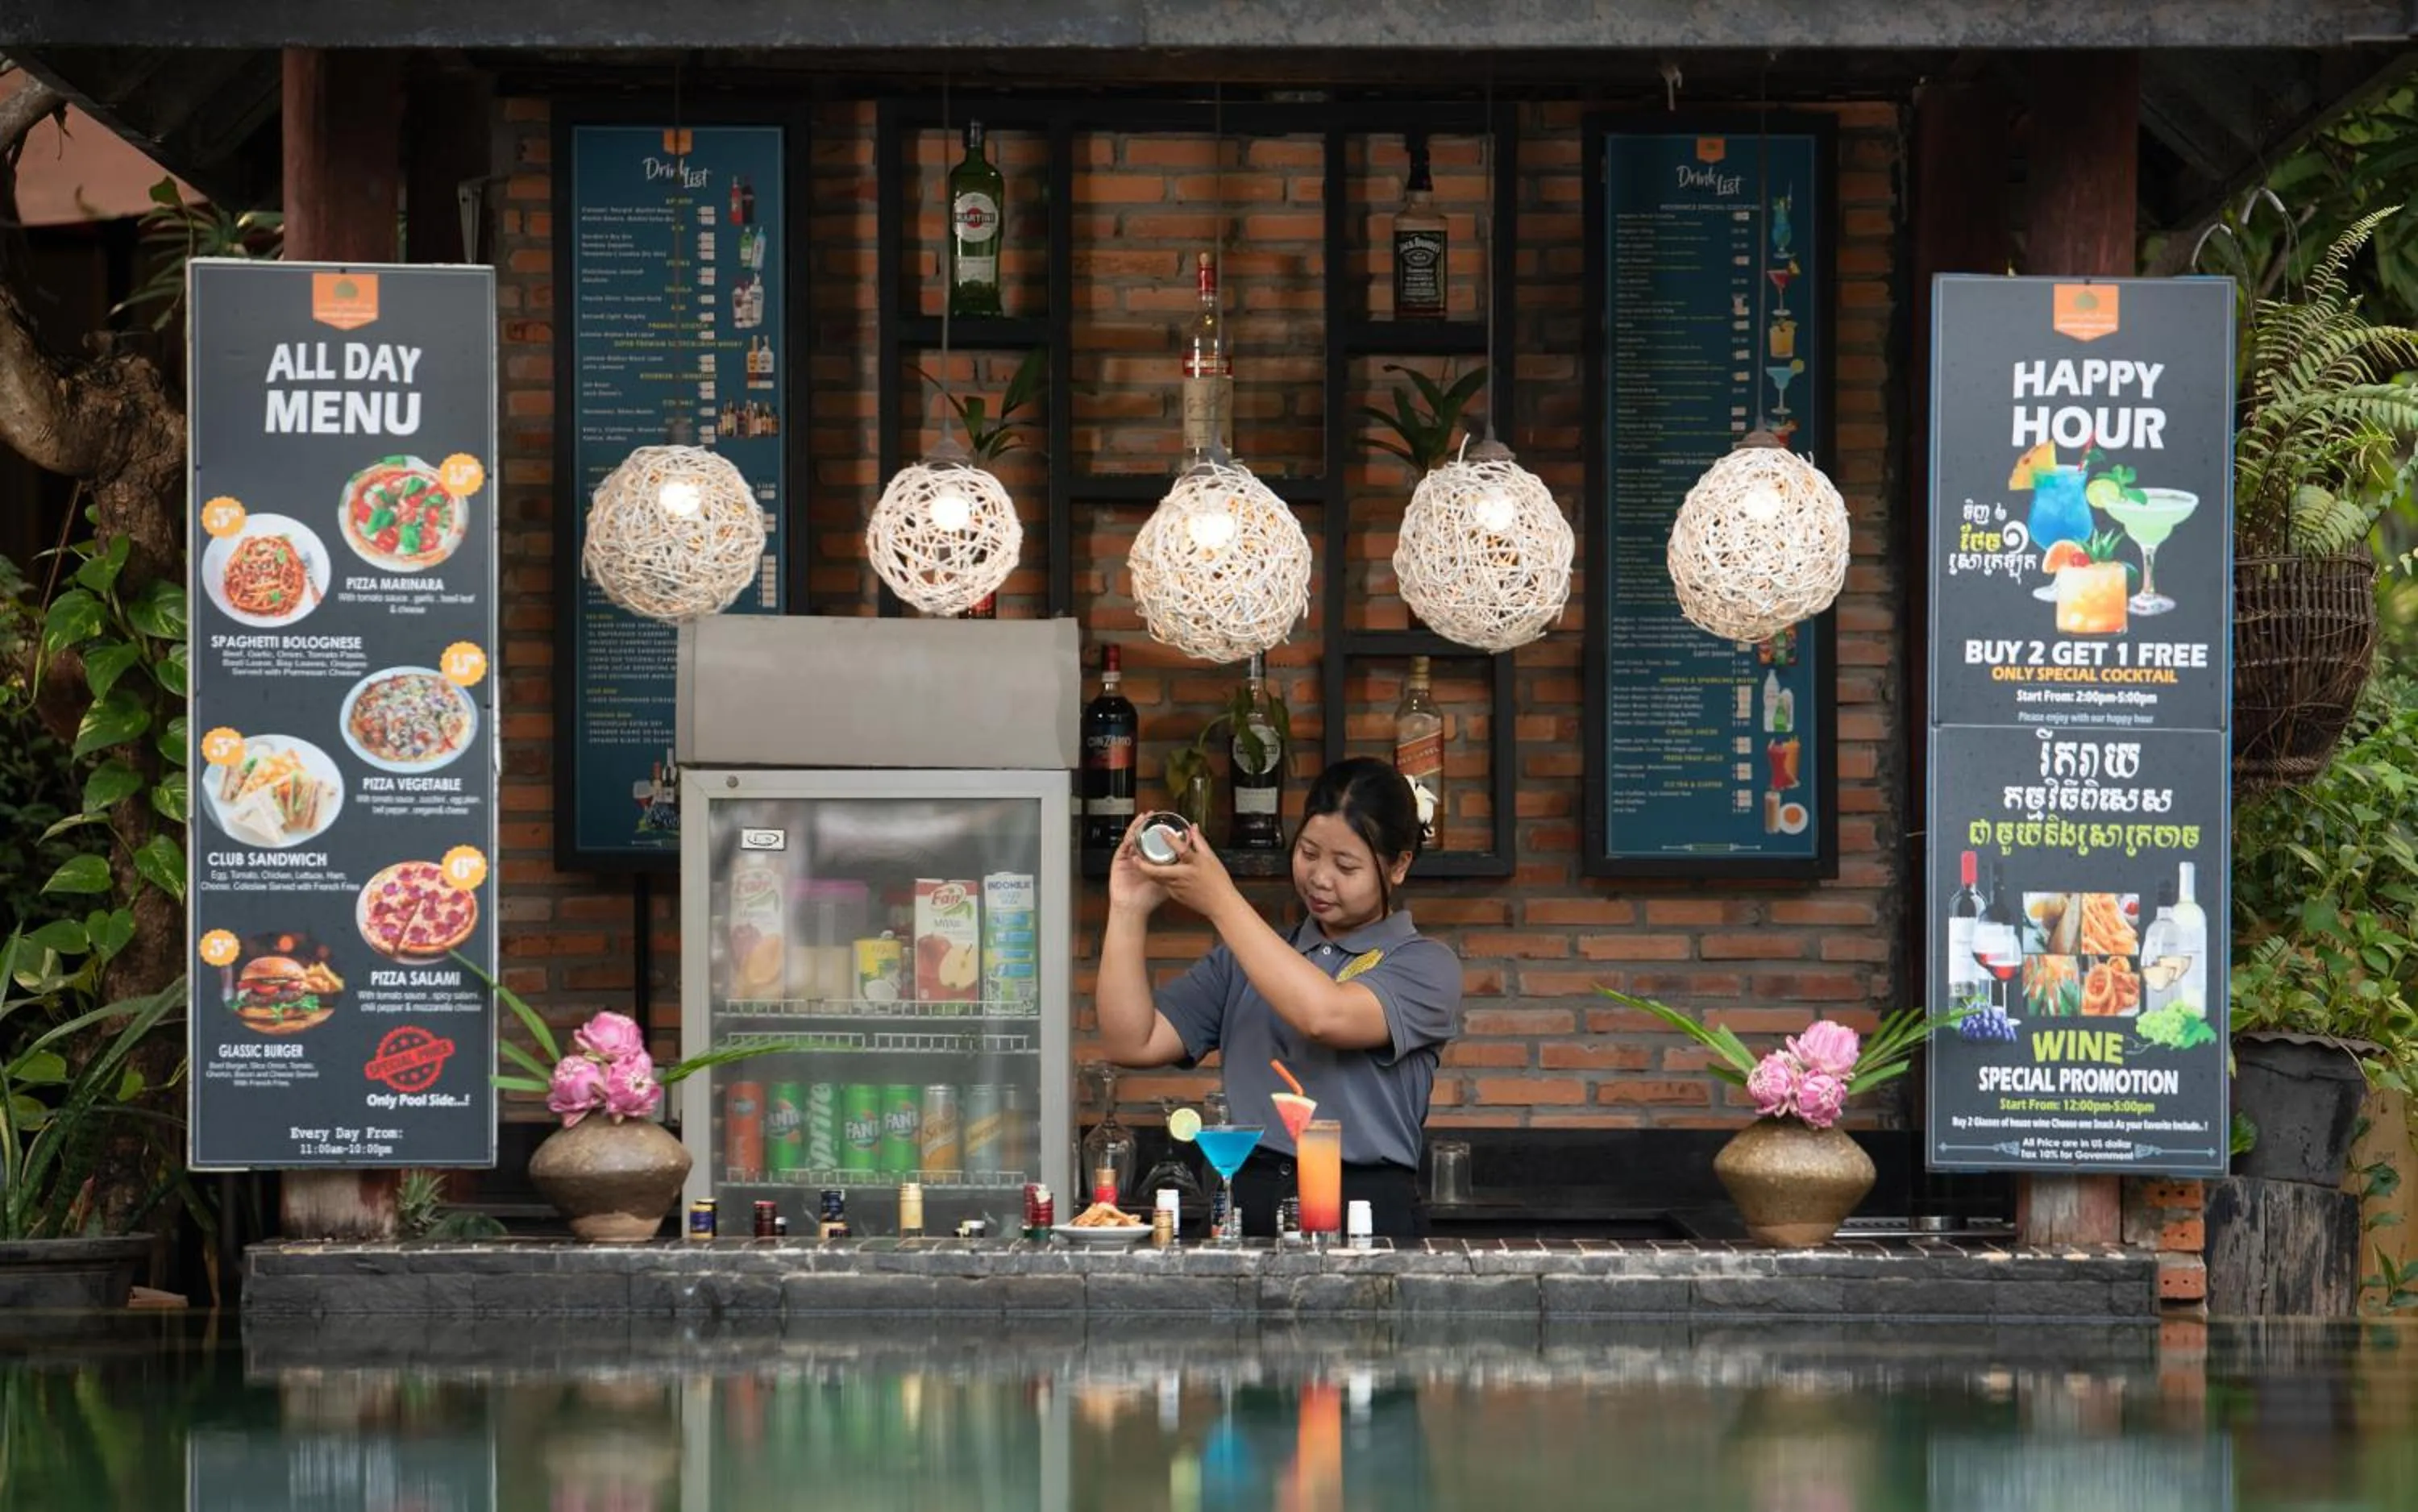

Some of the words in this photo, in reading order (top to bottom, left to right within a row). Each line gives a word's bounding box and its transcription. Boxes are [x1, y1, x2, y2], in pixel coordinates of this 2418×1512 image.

[1676, 164, 1716, 188] Drink
[1717, 176, 1746, 196] List
[266, 342, 335, 383] ALL
[344, 343, 422, 384] DAY
[2013, 359, 2164, 399] HAPPY
[265, 390, 422, 435] MENU
[2012, 406, 2167, 449] HOUR
[346, 577, 377, 590] PIZZA
[380, 578, 444, 591] MARINARA
[211, 635, 279, 648] SPAGHETTI
[283, 636, 362, 649] BOLOGNESE
[1965, 640, 2024, 664] BUY
[2028, 642, 2044, 665] 2
[2052, 642, 2108, 666] GET
[2117, 642, 2129, 666] 1
[2138, 642, 2208, 667] FREE
[1992, 667, 2033, 681] ONLY
[2037, 667, 2098, 683] SPECIAL
[2100, 669, 2179, 683] COCKTAIL
[2017, 690, 2042, 702] Start
[2044, 690, 2075, 703] From:
[2018, 712, 2044, 722] Please
[363, 778, 395, 791] PIZZA
[397, 778, 462, 791] VEGETABLE
[207, 852, 244, 866] CLUB
[247, 853, 328, 866] SANDWICH
[371, 971, 406, 986] PIZZA
[409, 971, 461, 986] SALAMI
[264, 1044, 304, 1057] BURGER
[2032, 1030, 2124, 1065] WINE
[1979, 1066, 2055, 1092] SPECIAL
[2059, 1068, 2178, 1095] PROMOTION
[367, 1094, 397, 1110] Only
[399, 1094, 427, 1107] Pool
[2000, 1099, 2026, 1111] Start
[2029, 1099, 2060, 1111] From:
[809, 1082, 837, 1170] prite
[290, 1127, 330, 1142] Every
[335, 1127, 360, 1143] Day
[366, 1127, 403, 1139] From:
[2022, 1136, 2035, 1147] All
[2037, 1137, 2060, 1148] Price
[2062, 1140, 2078, 1148] are
